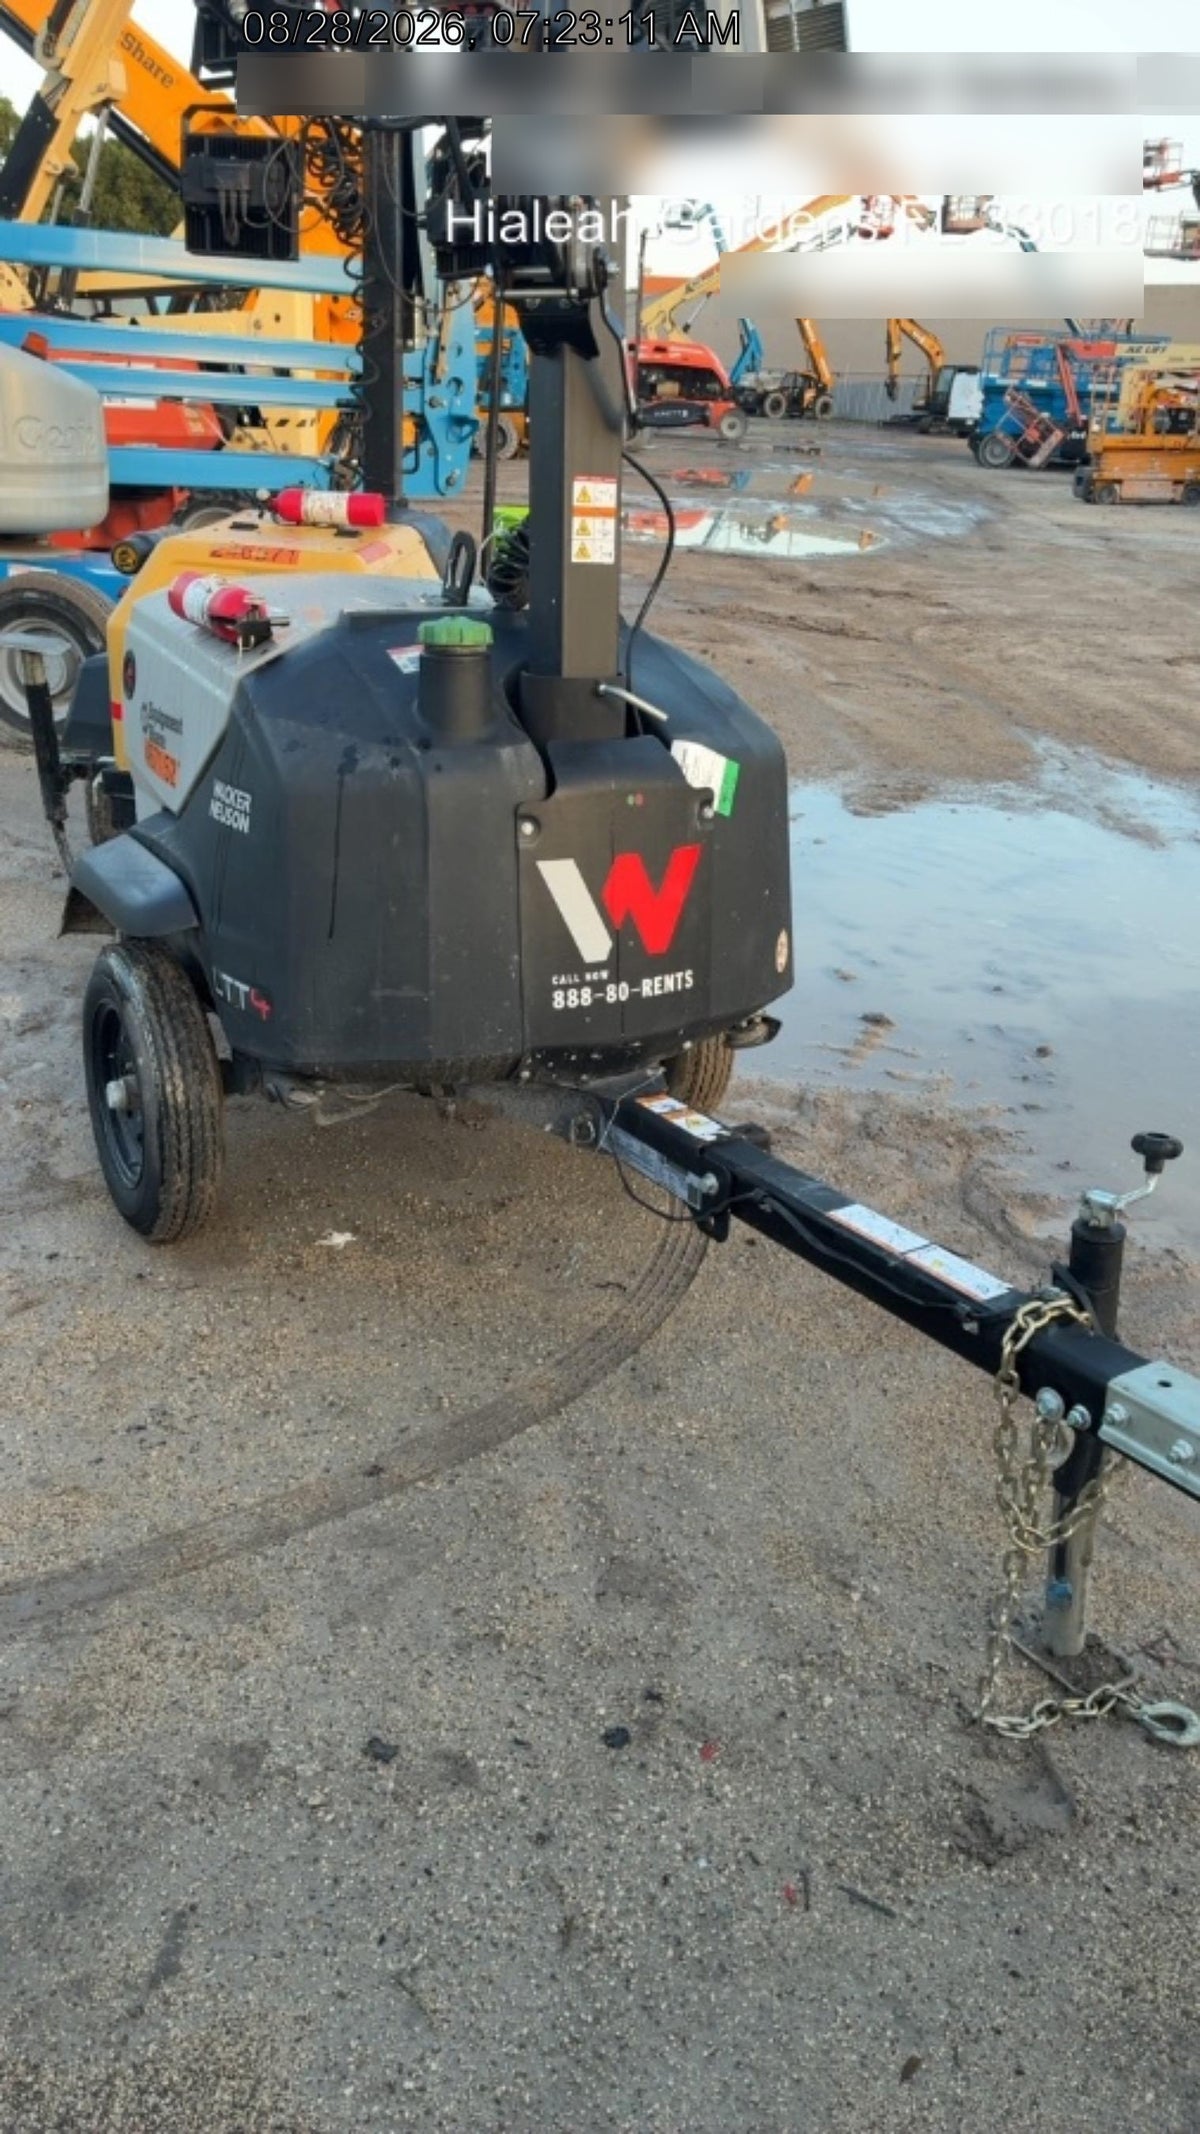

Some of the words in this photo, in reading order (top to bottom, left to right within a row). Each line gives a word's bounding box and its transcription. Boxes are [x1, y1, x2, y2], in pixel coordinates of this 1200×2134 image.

[121, 31, 174, 89] Share
[213, 779, 252, 813] WACKER
[209, 798, 250, 833] NEUSON
[552, 974, 580, 985] CALL
[552, 969, 694, 1010] 888-80-RENTS
